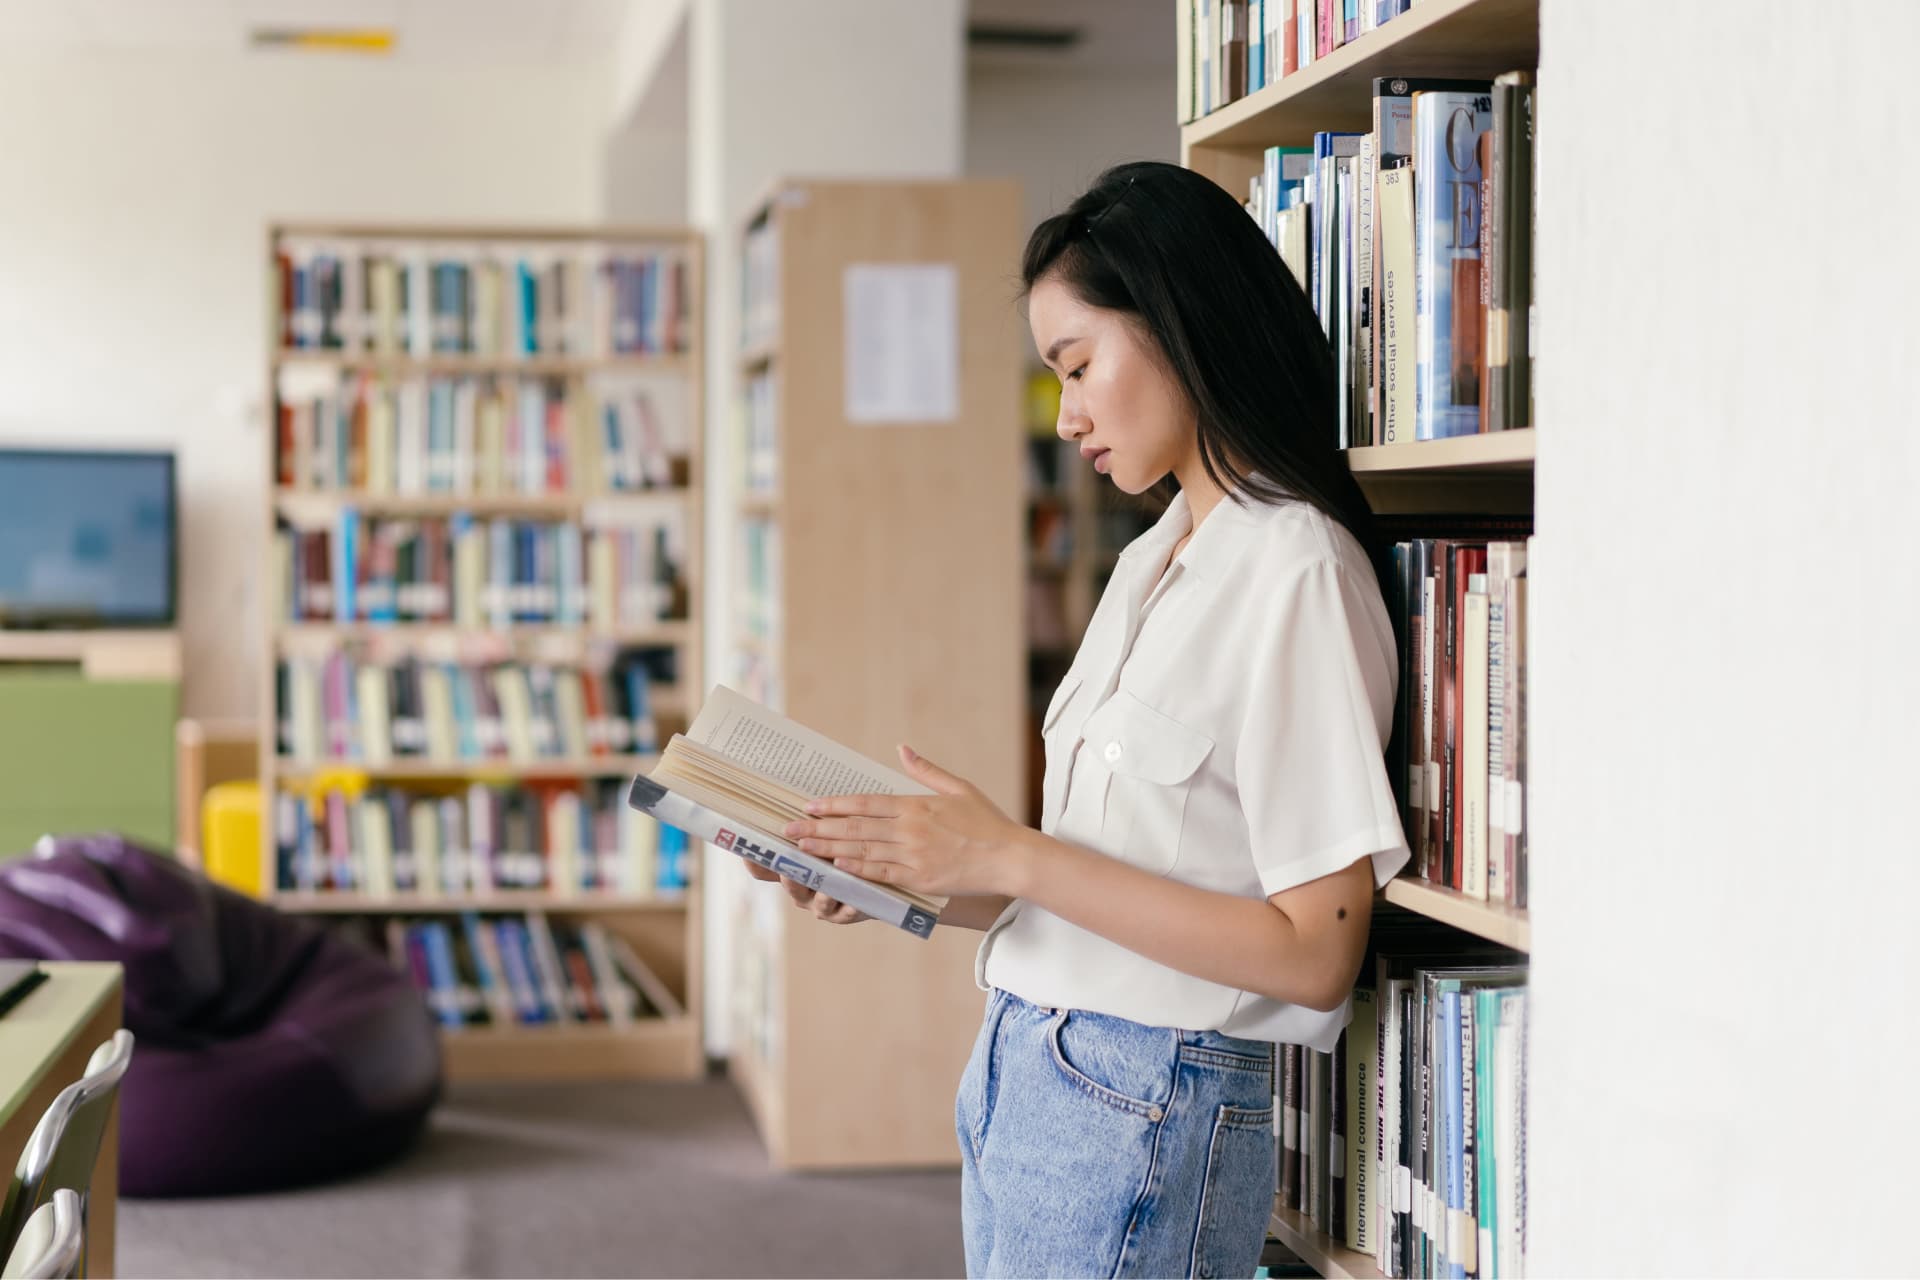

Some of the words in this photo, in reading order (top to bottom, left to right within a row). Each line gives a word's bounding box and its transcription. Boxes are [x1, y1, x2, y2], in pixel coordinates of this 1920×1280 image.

[1385, 171, 1400, 186] 363
[1387, 270, 1397, 339] services
[1388, 343, 1397, 392] social
[1387, 396, 1396, 443] Other
[1357, 1062, 1367, 1145] commerce
[1460, 994, 1474, 1150] INTERNATIONAL
[1356, 1147, 1367, 1248] International
[1462, 1152, 1472, 1216] ECONO
